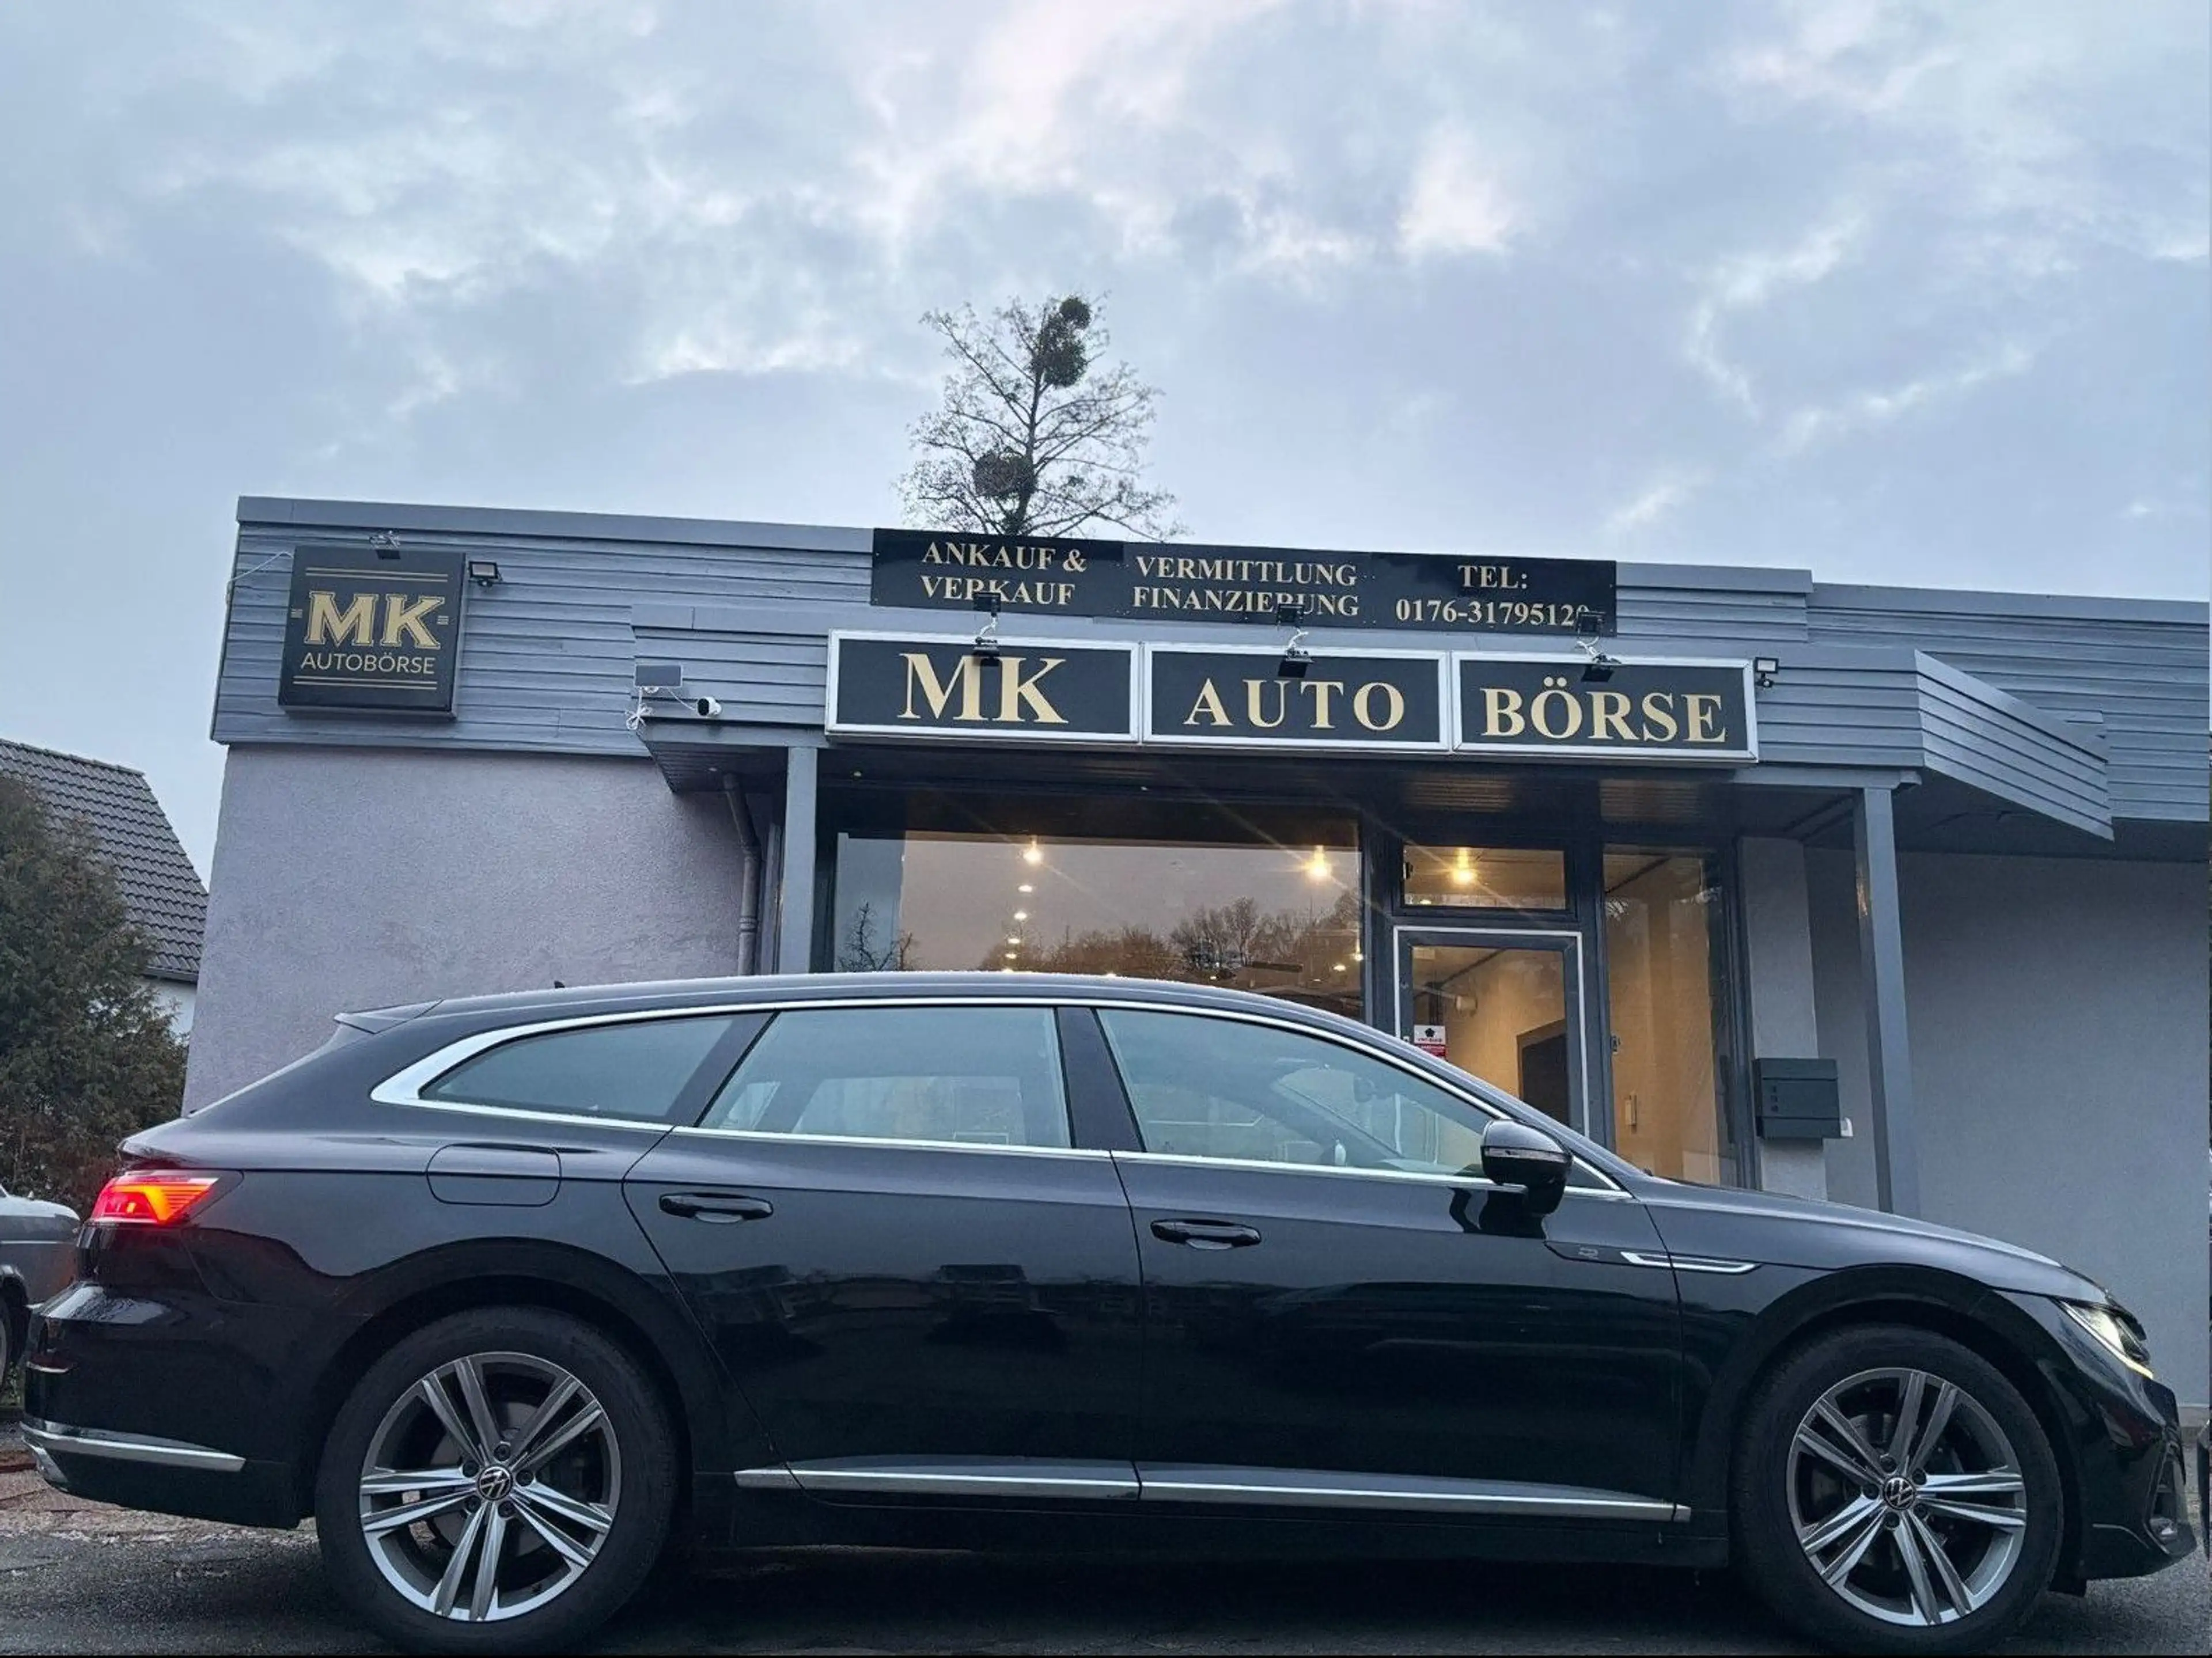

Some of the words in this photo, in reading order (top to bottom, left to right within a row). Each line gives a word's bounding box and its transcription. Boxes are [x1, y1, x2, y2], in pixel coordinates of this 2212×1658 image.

[922, 541, 1056, 570] ANKAUF
[1062, 549, 1087, 572] &
[1137, 556, 1357, 586] VERMITTLUNG
[1457, 565, 1528, 589] TEL:
[304, 591, 445, 650] MK
[300, 652, 436, 674] AUTOBÖRSE
[897, 652, 1069, 724] MK
[1183, 678, 1405, 731] AUTO
[1480, 677, 1727, 743] BÖRSE
